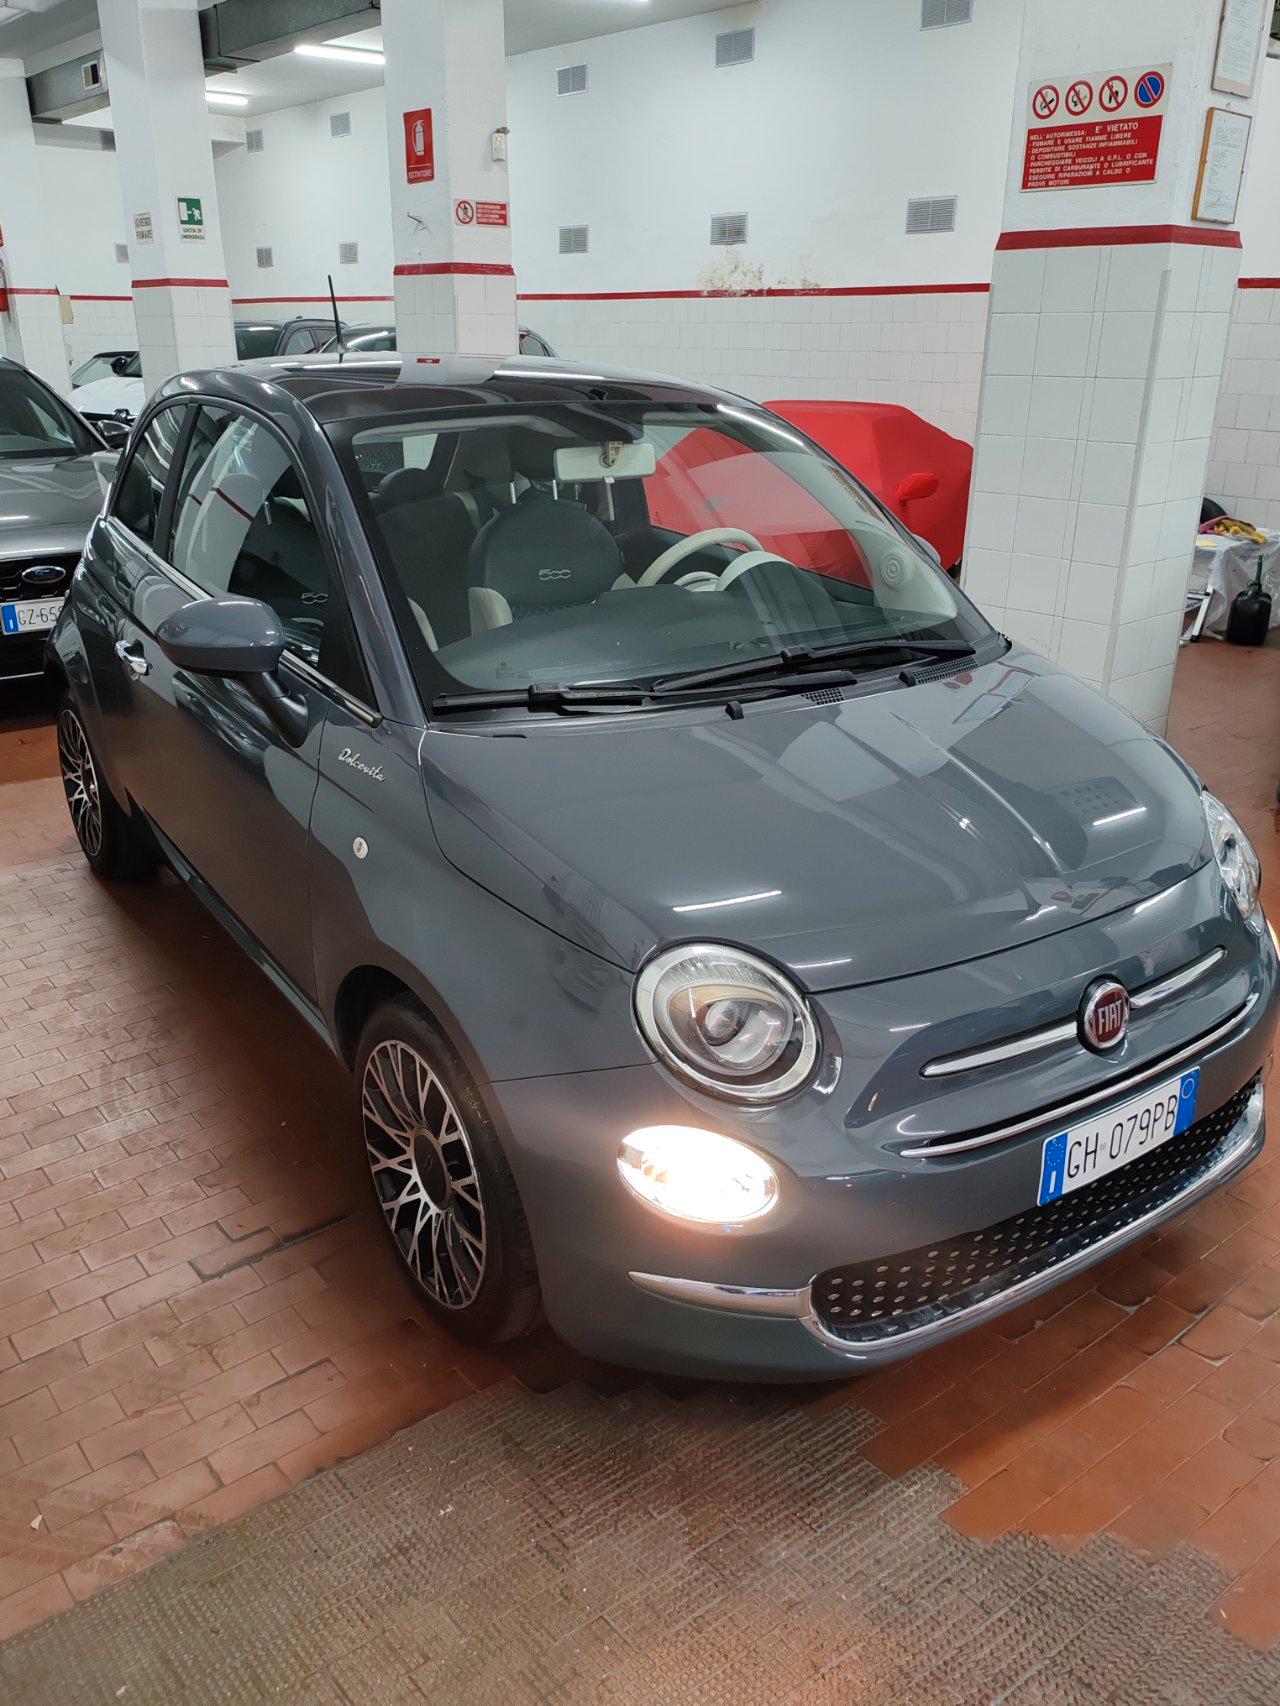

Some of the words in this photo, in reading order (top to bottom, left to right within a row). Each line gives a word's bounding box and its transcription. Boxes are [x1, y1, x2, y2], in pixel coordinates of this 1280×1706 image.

[1107, 122, 1139, 132] VIETATO
[1032, 139, 1055, 147] FUMARE
[1064, 137, 1083, 145] USARE
[1086, 134, 1108, 142] FIAMME
[1110, 132, 1132, 140] LIBERE
[1031, 145, 1065, 154] DEPOSITARE
[1068, 142, 1097, 151] SOSTANZE
[1098, 139, 1138, 148] INFIAMMABILI
[1030, 158, 1072, 167] PARCHEGGIARE
[1075, 156, 1098, 164] VEICOLI
[1037, 151, 1076, 160] COMBUSTIBILI
[1029, 167, 1052, 175] PERDITE
[1063, 162, 1101, 171] CARBURANTE
[1111, 158, 1153, 168] LUBRIFICANTE
[1028, 173, 1056, 181] ESEGUIRE
[1028, 180, 1046, 188] PROVE
[539, 569, 572, 580] 500
[338, 748, 386, 781] Dolcevita
[1097, 999, 1123, 1036] FIAT
[1067, 1132, 1099, 1179] GH
[1109, 1094, 1178, 1160] 079PB
